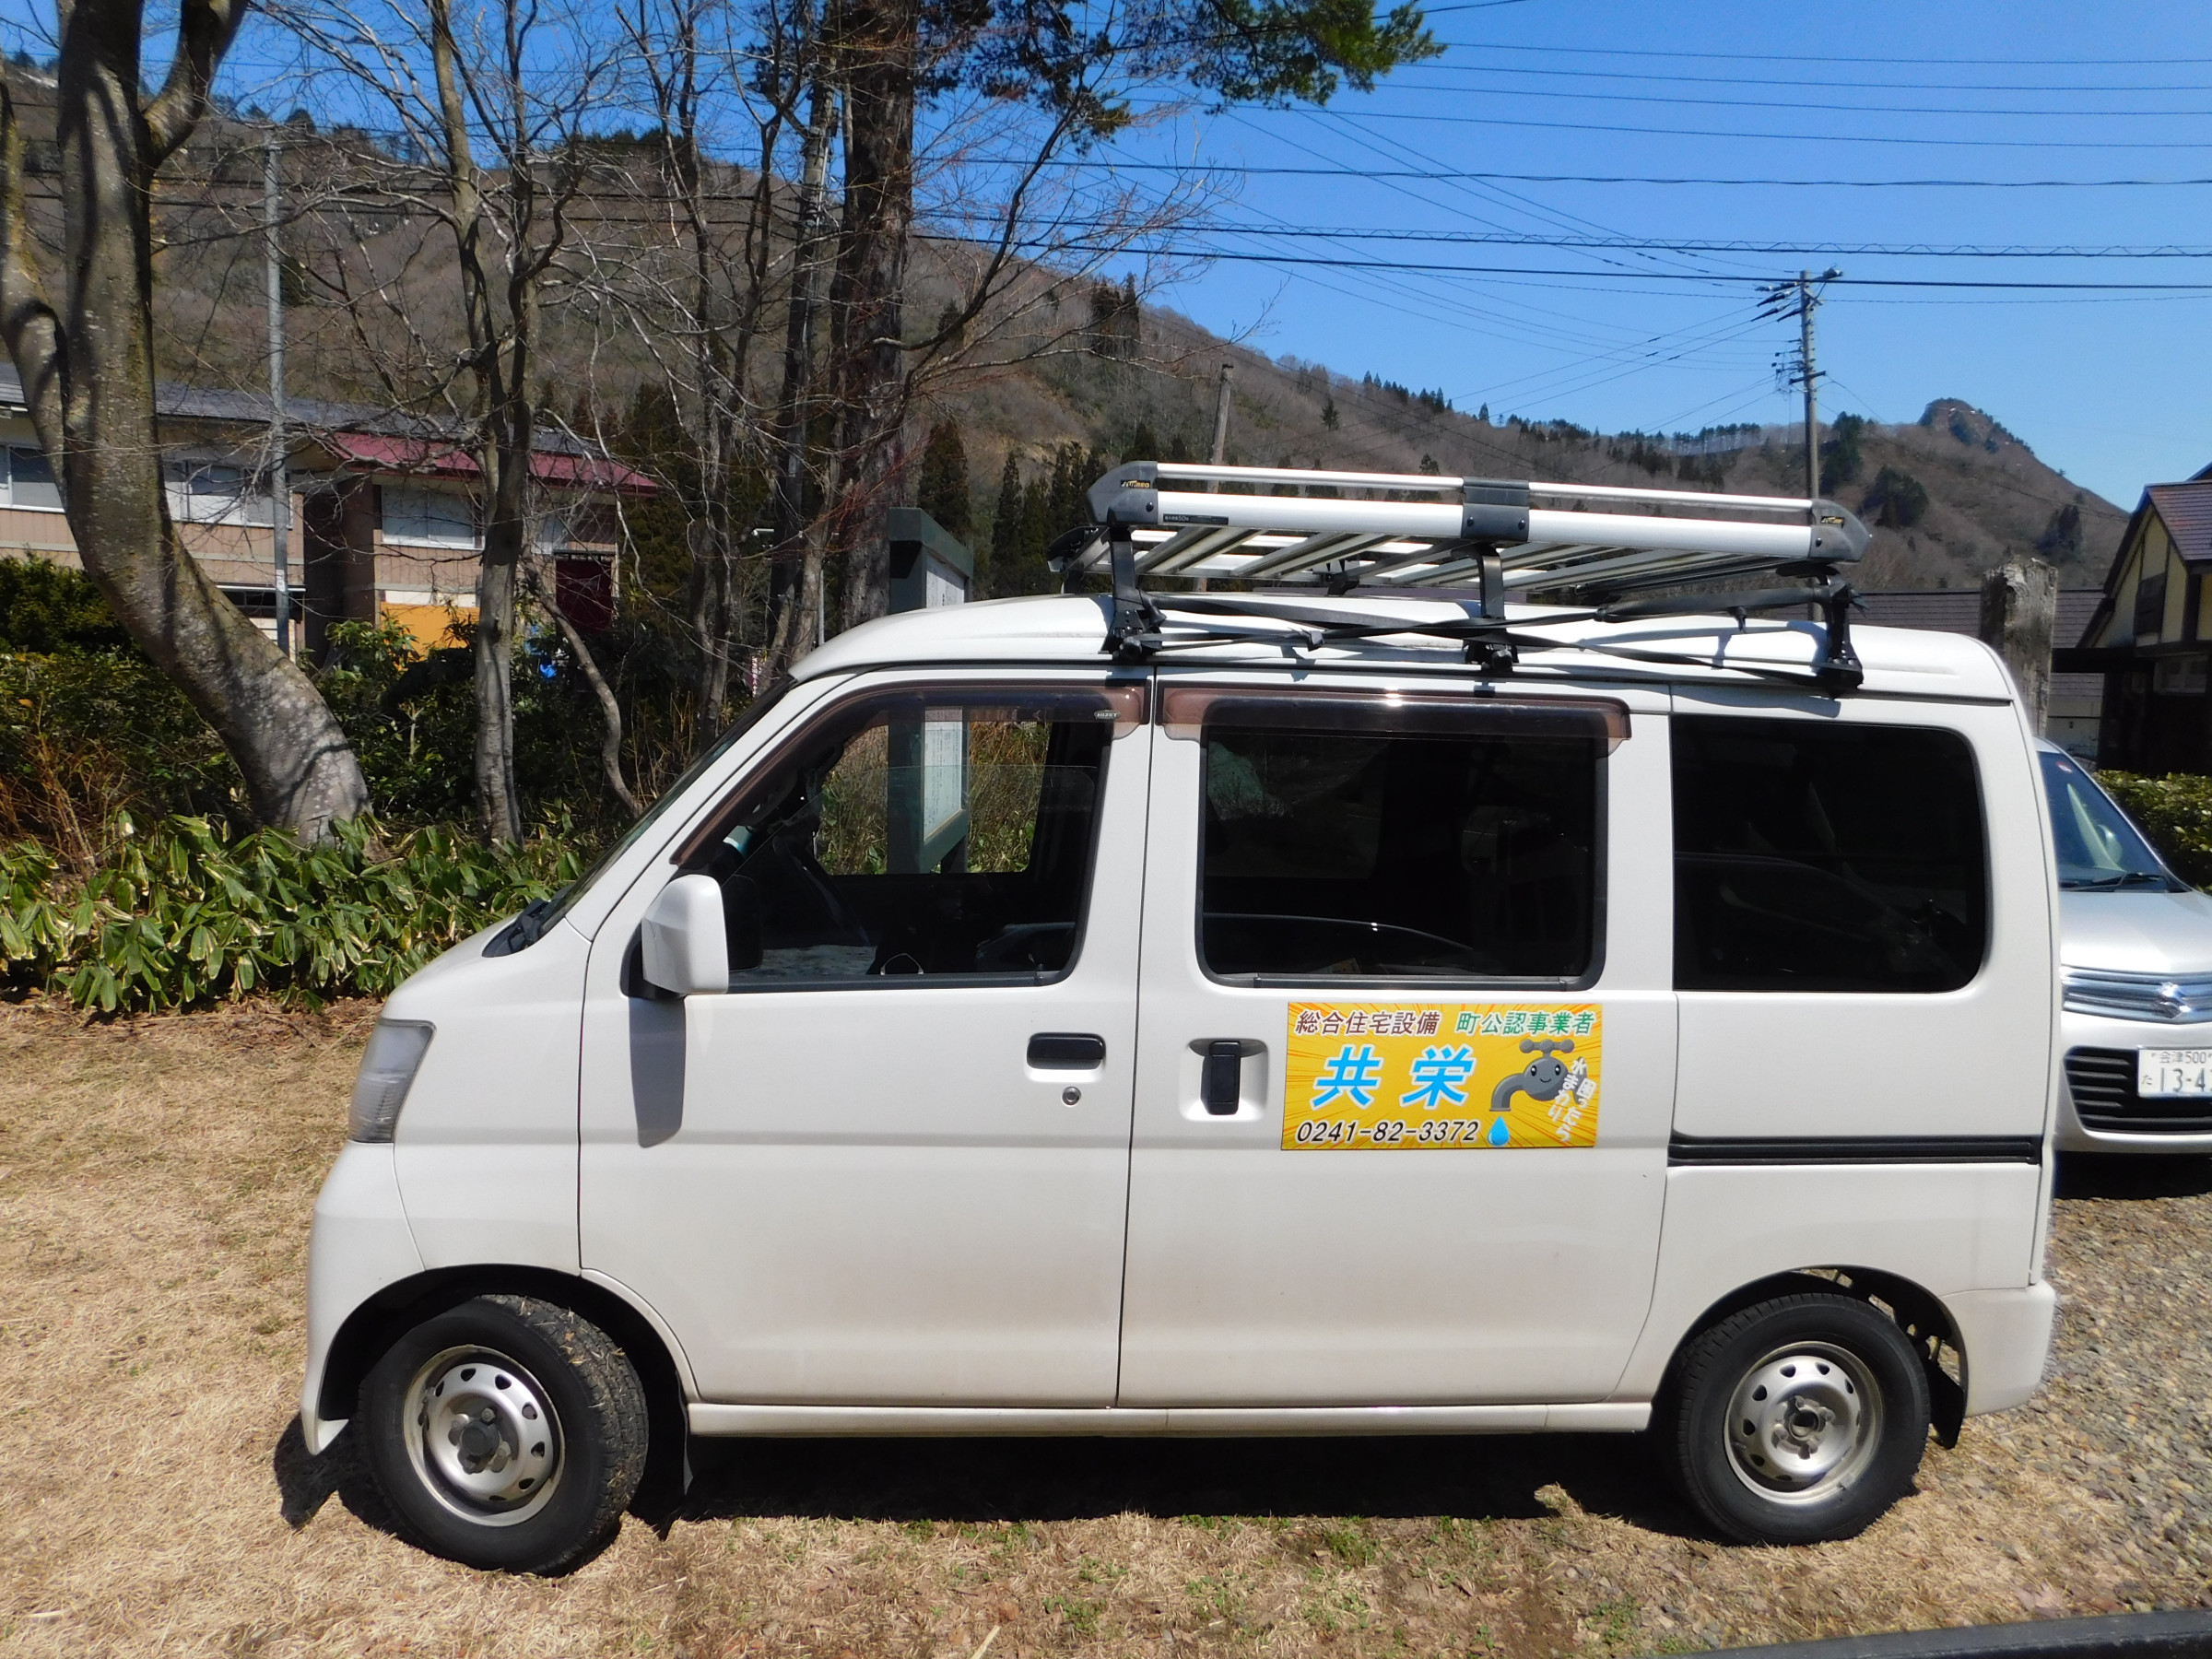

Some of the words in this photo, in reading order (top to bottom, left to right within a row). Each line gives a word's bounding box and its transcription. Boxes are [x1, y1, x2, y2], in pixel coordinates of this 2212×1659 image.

[1295, 1010, 1441, 1035] 総合住宅設備
[1454, 1011, 1594, 1036] 町公認事業者
[1547, 1057, 1588, 1123] 水まわり
[2159, 1067, 2212, 1093] 13-4
[1295, 1121, 1480, 1143] 0241-82-3372
